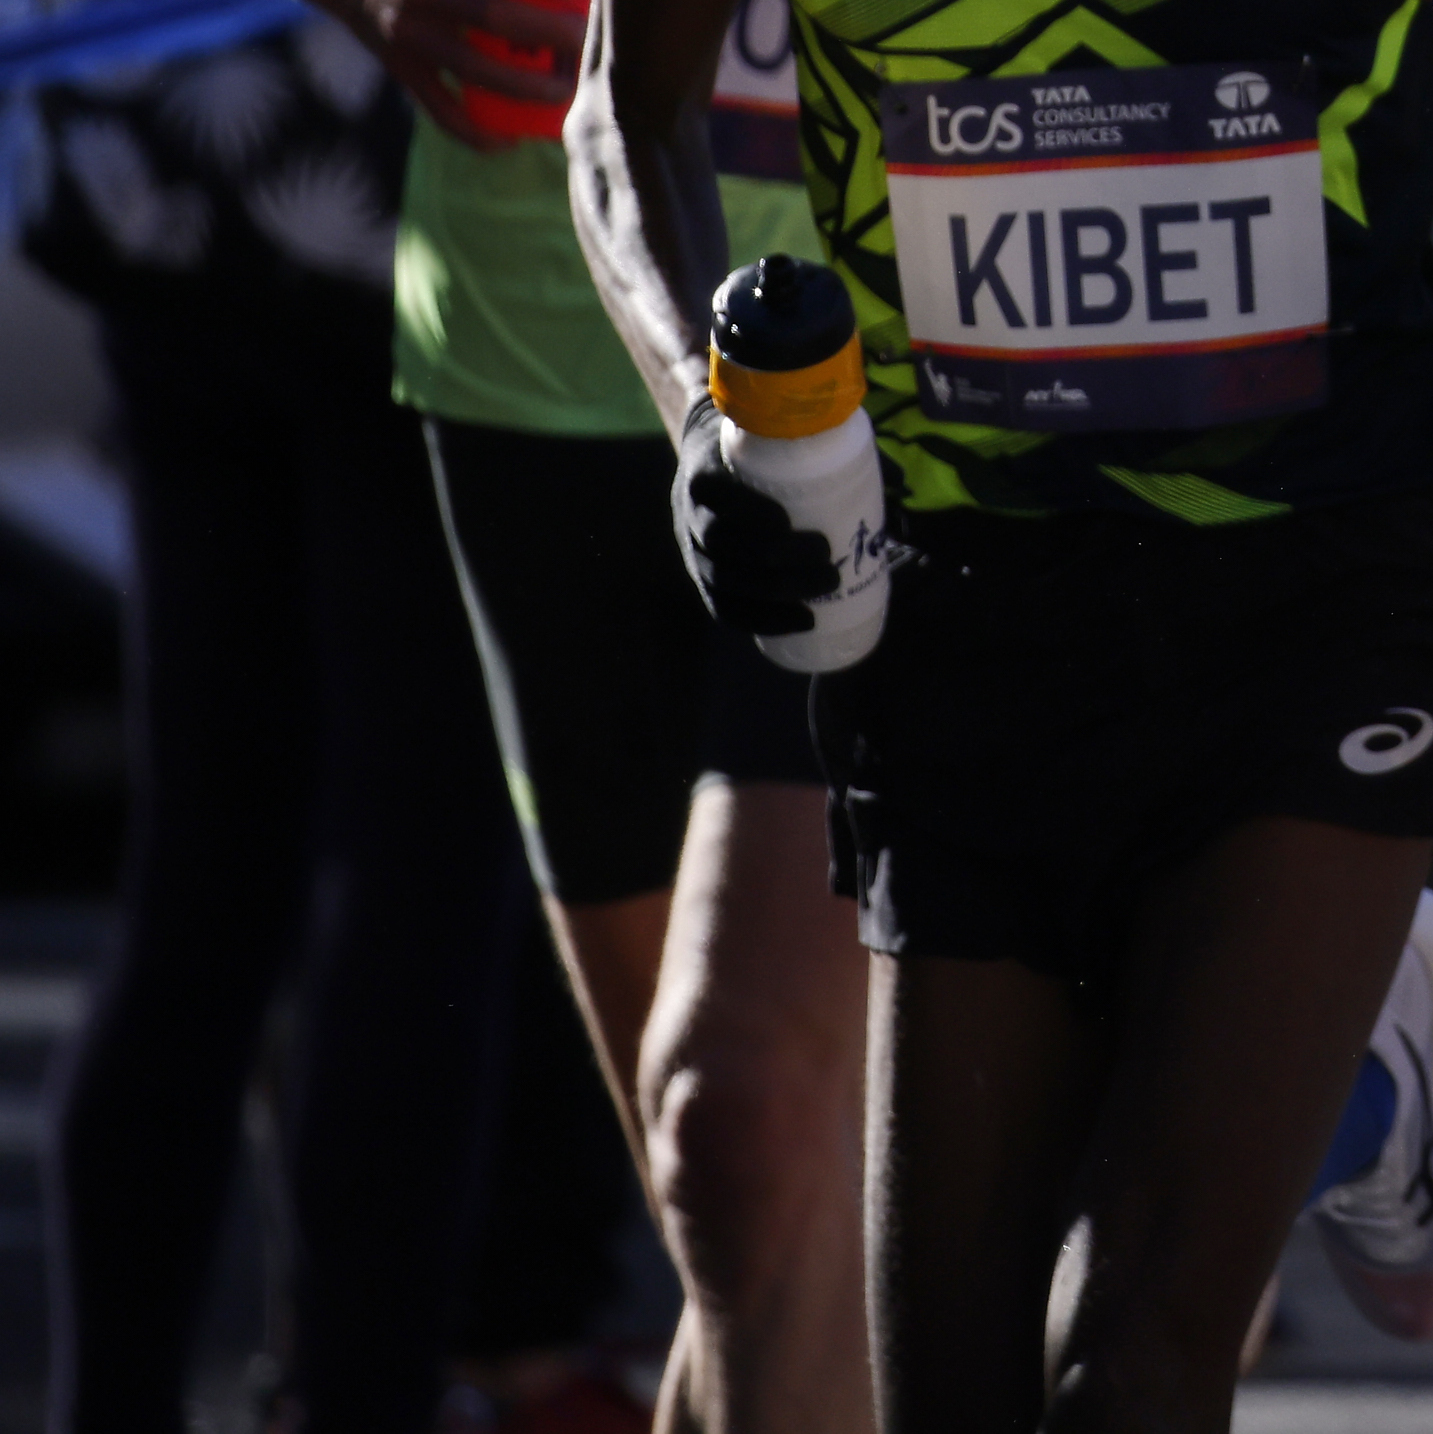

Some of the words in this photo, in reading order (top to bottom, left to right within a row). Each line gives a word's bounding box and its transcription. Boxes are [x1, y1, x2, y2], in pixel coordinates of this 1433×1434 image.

[1030, 86, 1091, 106] TATA
[926, 94, 1023, 155] tcs
[1032, 101, 1172, 127] CONSULTANCY
[1207, 112, 1281, 140] TATA
[1034, 125, 1124, 149] SERVICES
[949, 196, 1270, 328] KIBET
